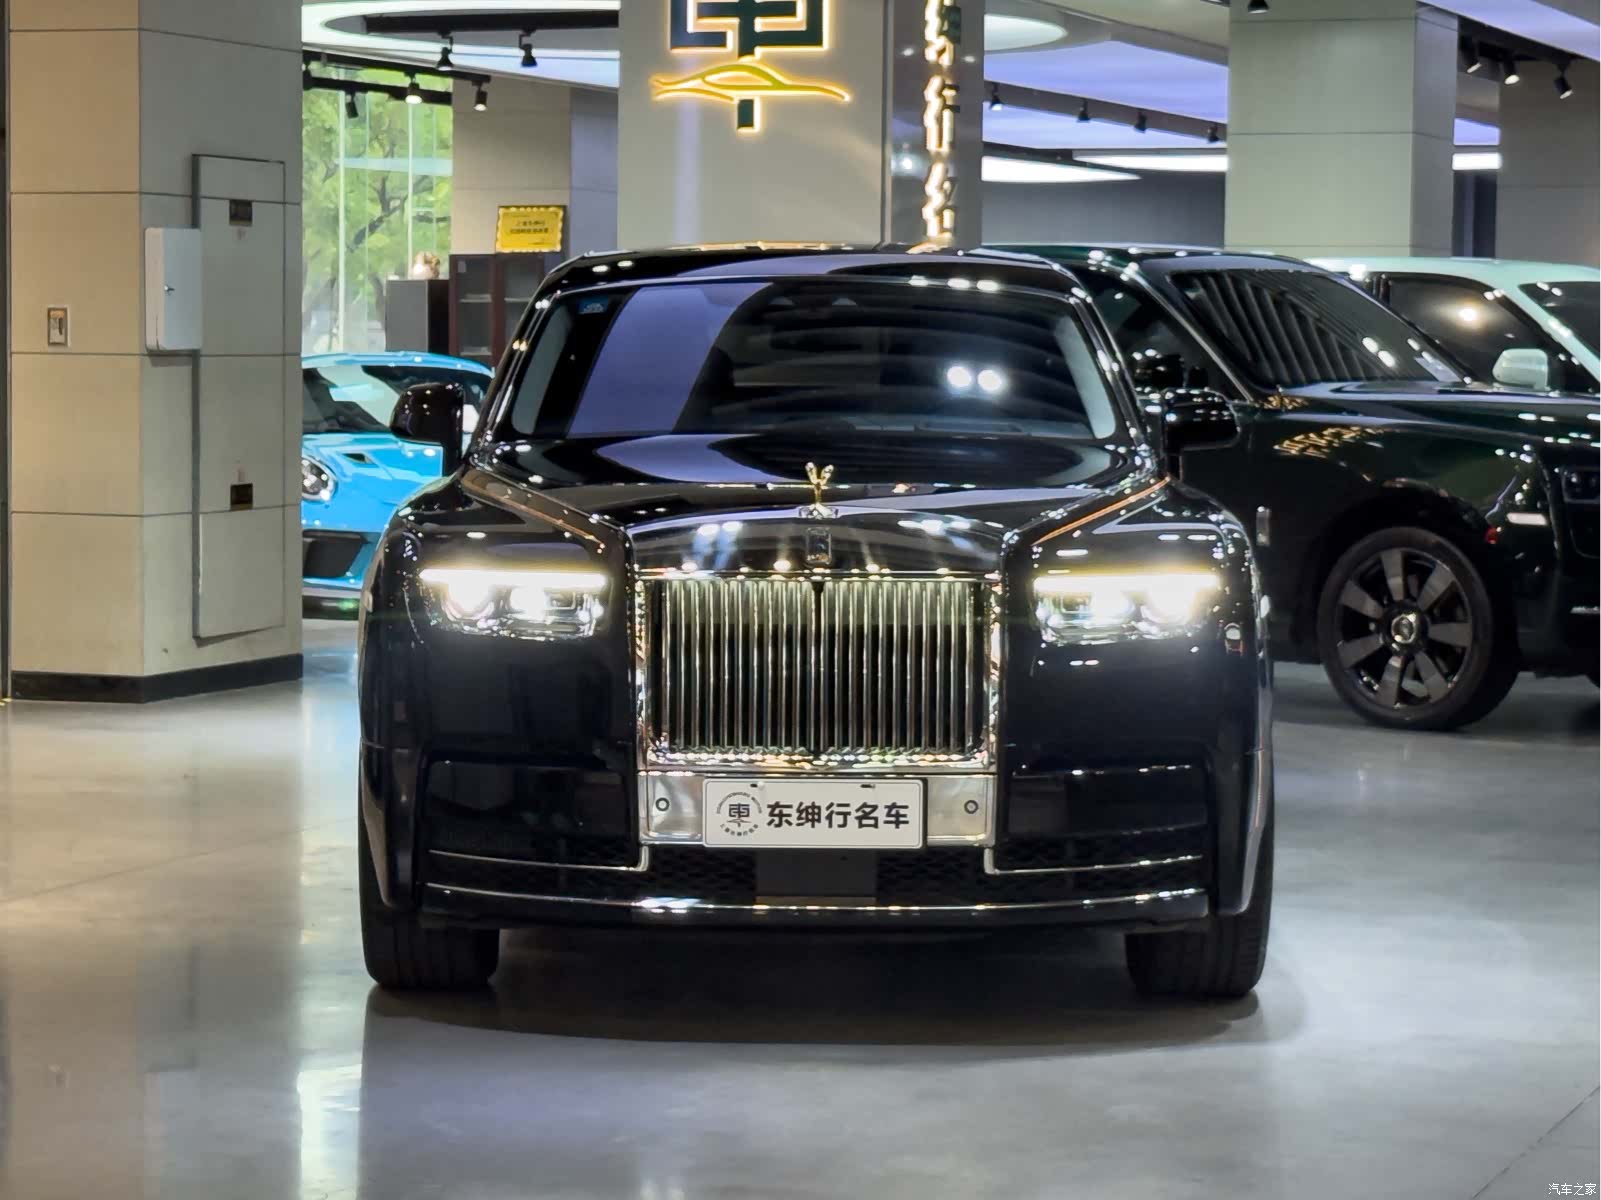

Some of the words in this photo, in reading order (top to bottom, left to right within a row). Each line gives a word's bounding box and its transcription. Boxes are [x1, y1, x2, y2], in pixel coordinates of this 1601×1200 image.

[766, 801, 910, 829] 东绅行名车
